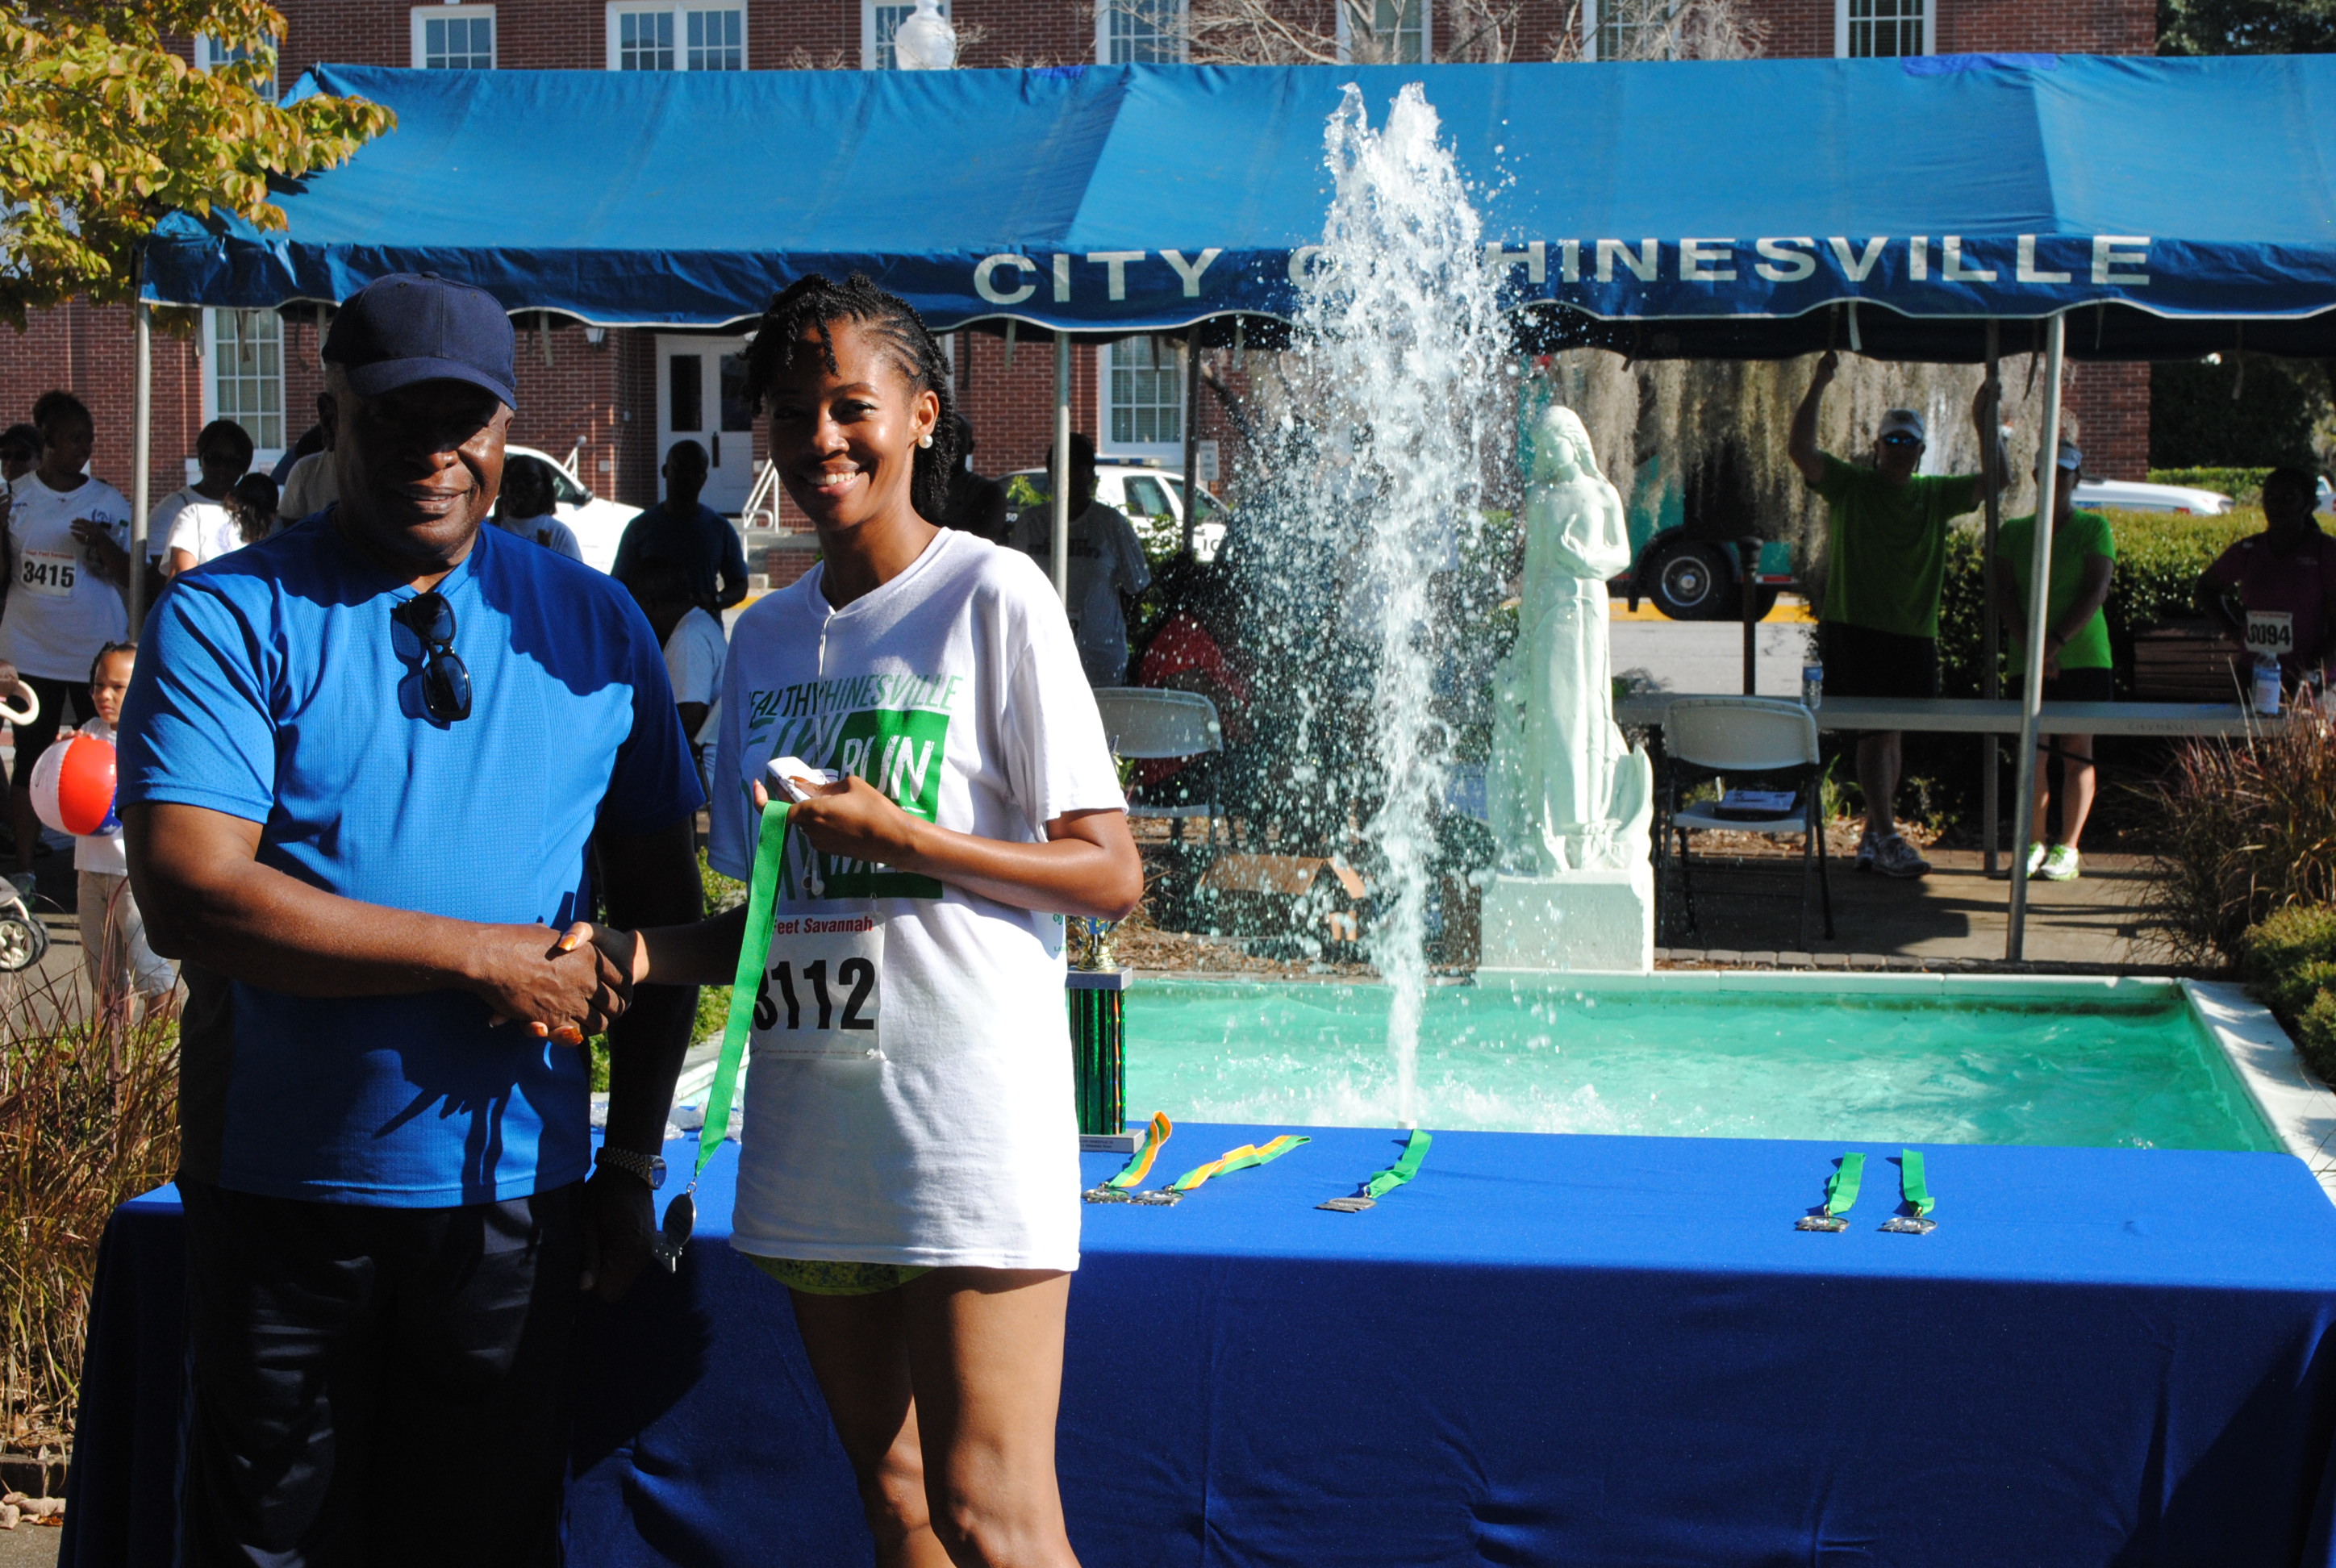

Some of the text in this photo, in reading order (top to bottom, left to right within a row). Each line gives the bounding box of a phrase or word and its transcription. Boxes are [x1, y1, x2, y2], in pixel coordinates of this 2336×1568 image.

[974, 248, 1223, 305] CITY
[1486, 235, 2150, 286] HINESVILLE
[23, 561, 75, 589] 3415
[2246, 623, 2291, 646] 3094
[840, 735, 935, 803] RUN
[803, 915, 873, 934] Savannah
